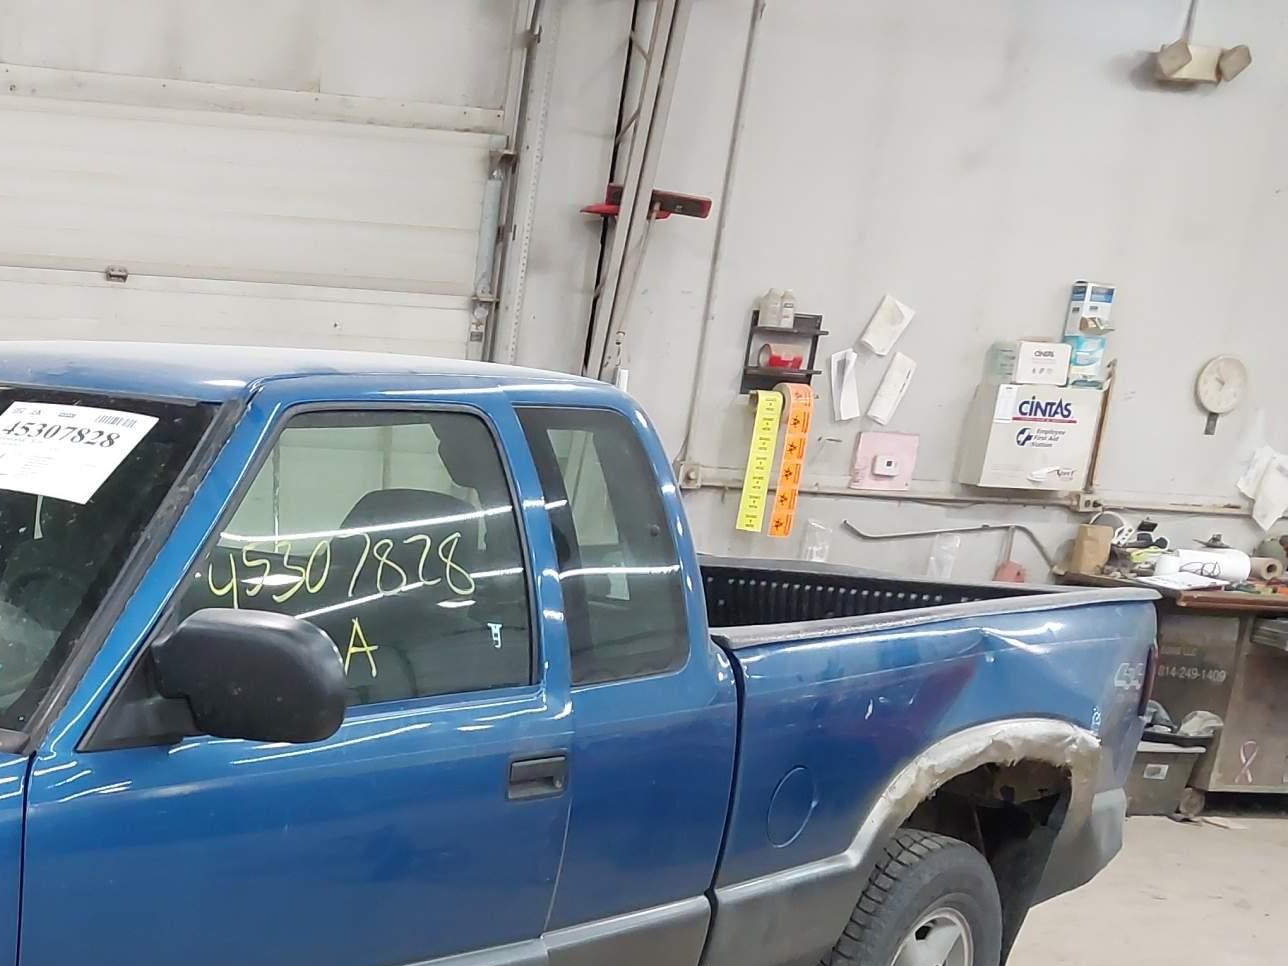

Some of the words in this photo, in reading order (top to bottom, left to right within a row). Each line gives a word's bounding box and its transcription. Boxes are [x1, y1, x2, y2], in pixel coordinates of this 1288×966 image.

[2, 420, 120, 448] 45307828
[208, 532, 475, 609] 45307828
[344, 617, 378, 678] A
